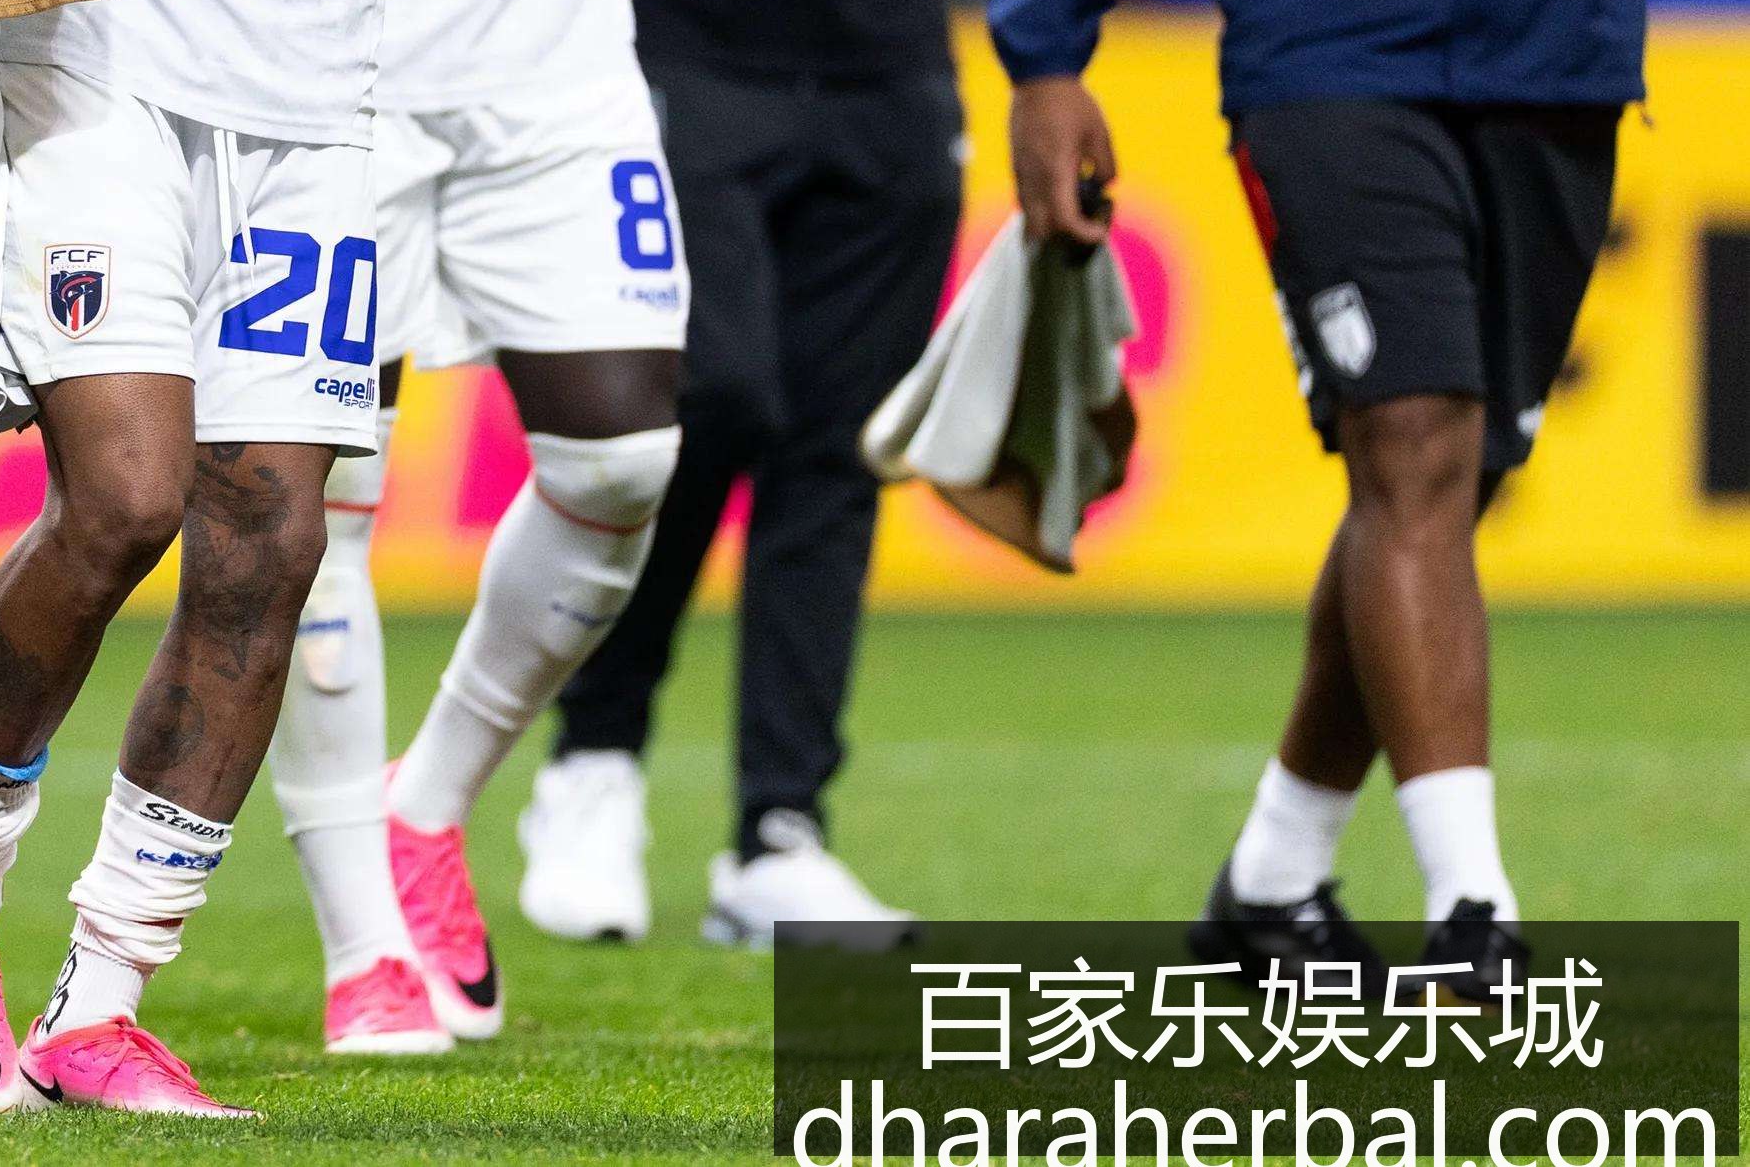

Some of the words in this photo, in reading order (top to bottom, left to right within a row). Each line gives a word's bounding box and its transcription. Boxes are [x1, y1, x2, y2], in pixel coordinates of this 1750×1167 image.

[611, 160, 674, 271] 8
[51, 249, 105, 265] FCF
[218, 226, 378, 367] 20
[314, 376, 376, 404] capelli
